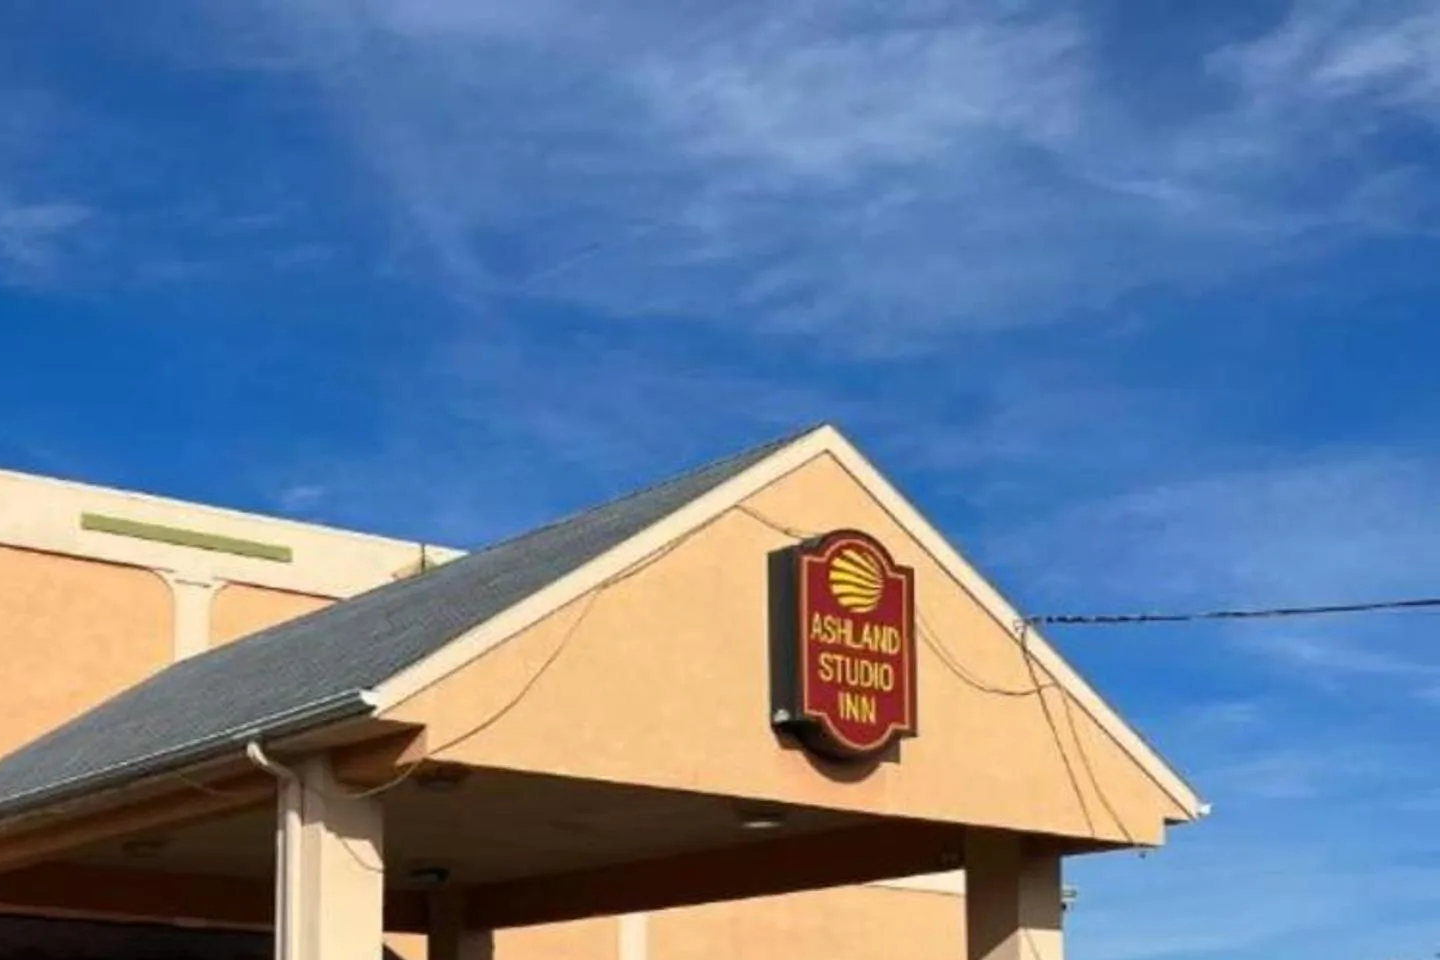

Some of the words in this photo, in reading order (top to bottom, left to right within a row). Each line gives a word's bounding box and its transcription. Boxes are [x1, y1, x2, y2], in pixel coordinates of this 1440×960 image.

[810, 612, 900, 655] ASHLAND
[818, 652, 894, 691] STUDIO
[838, 691, 876, 724] INN
